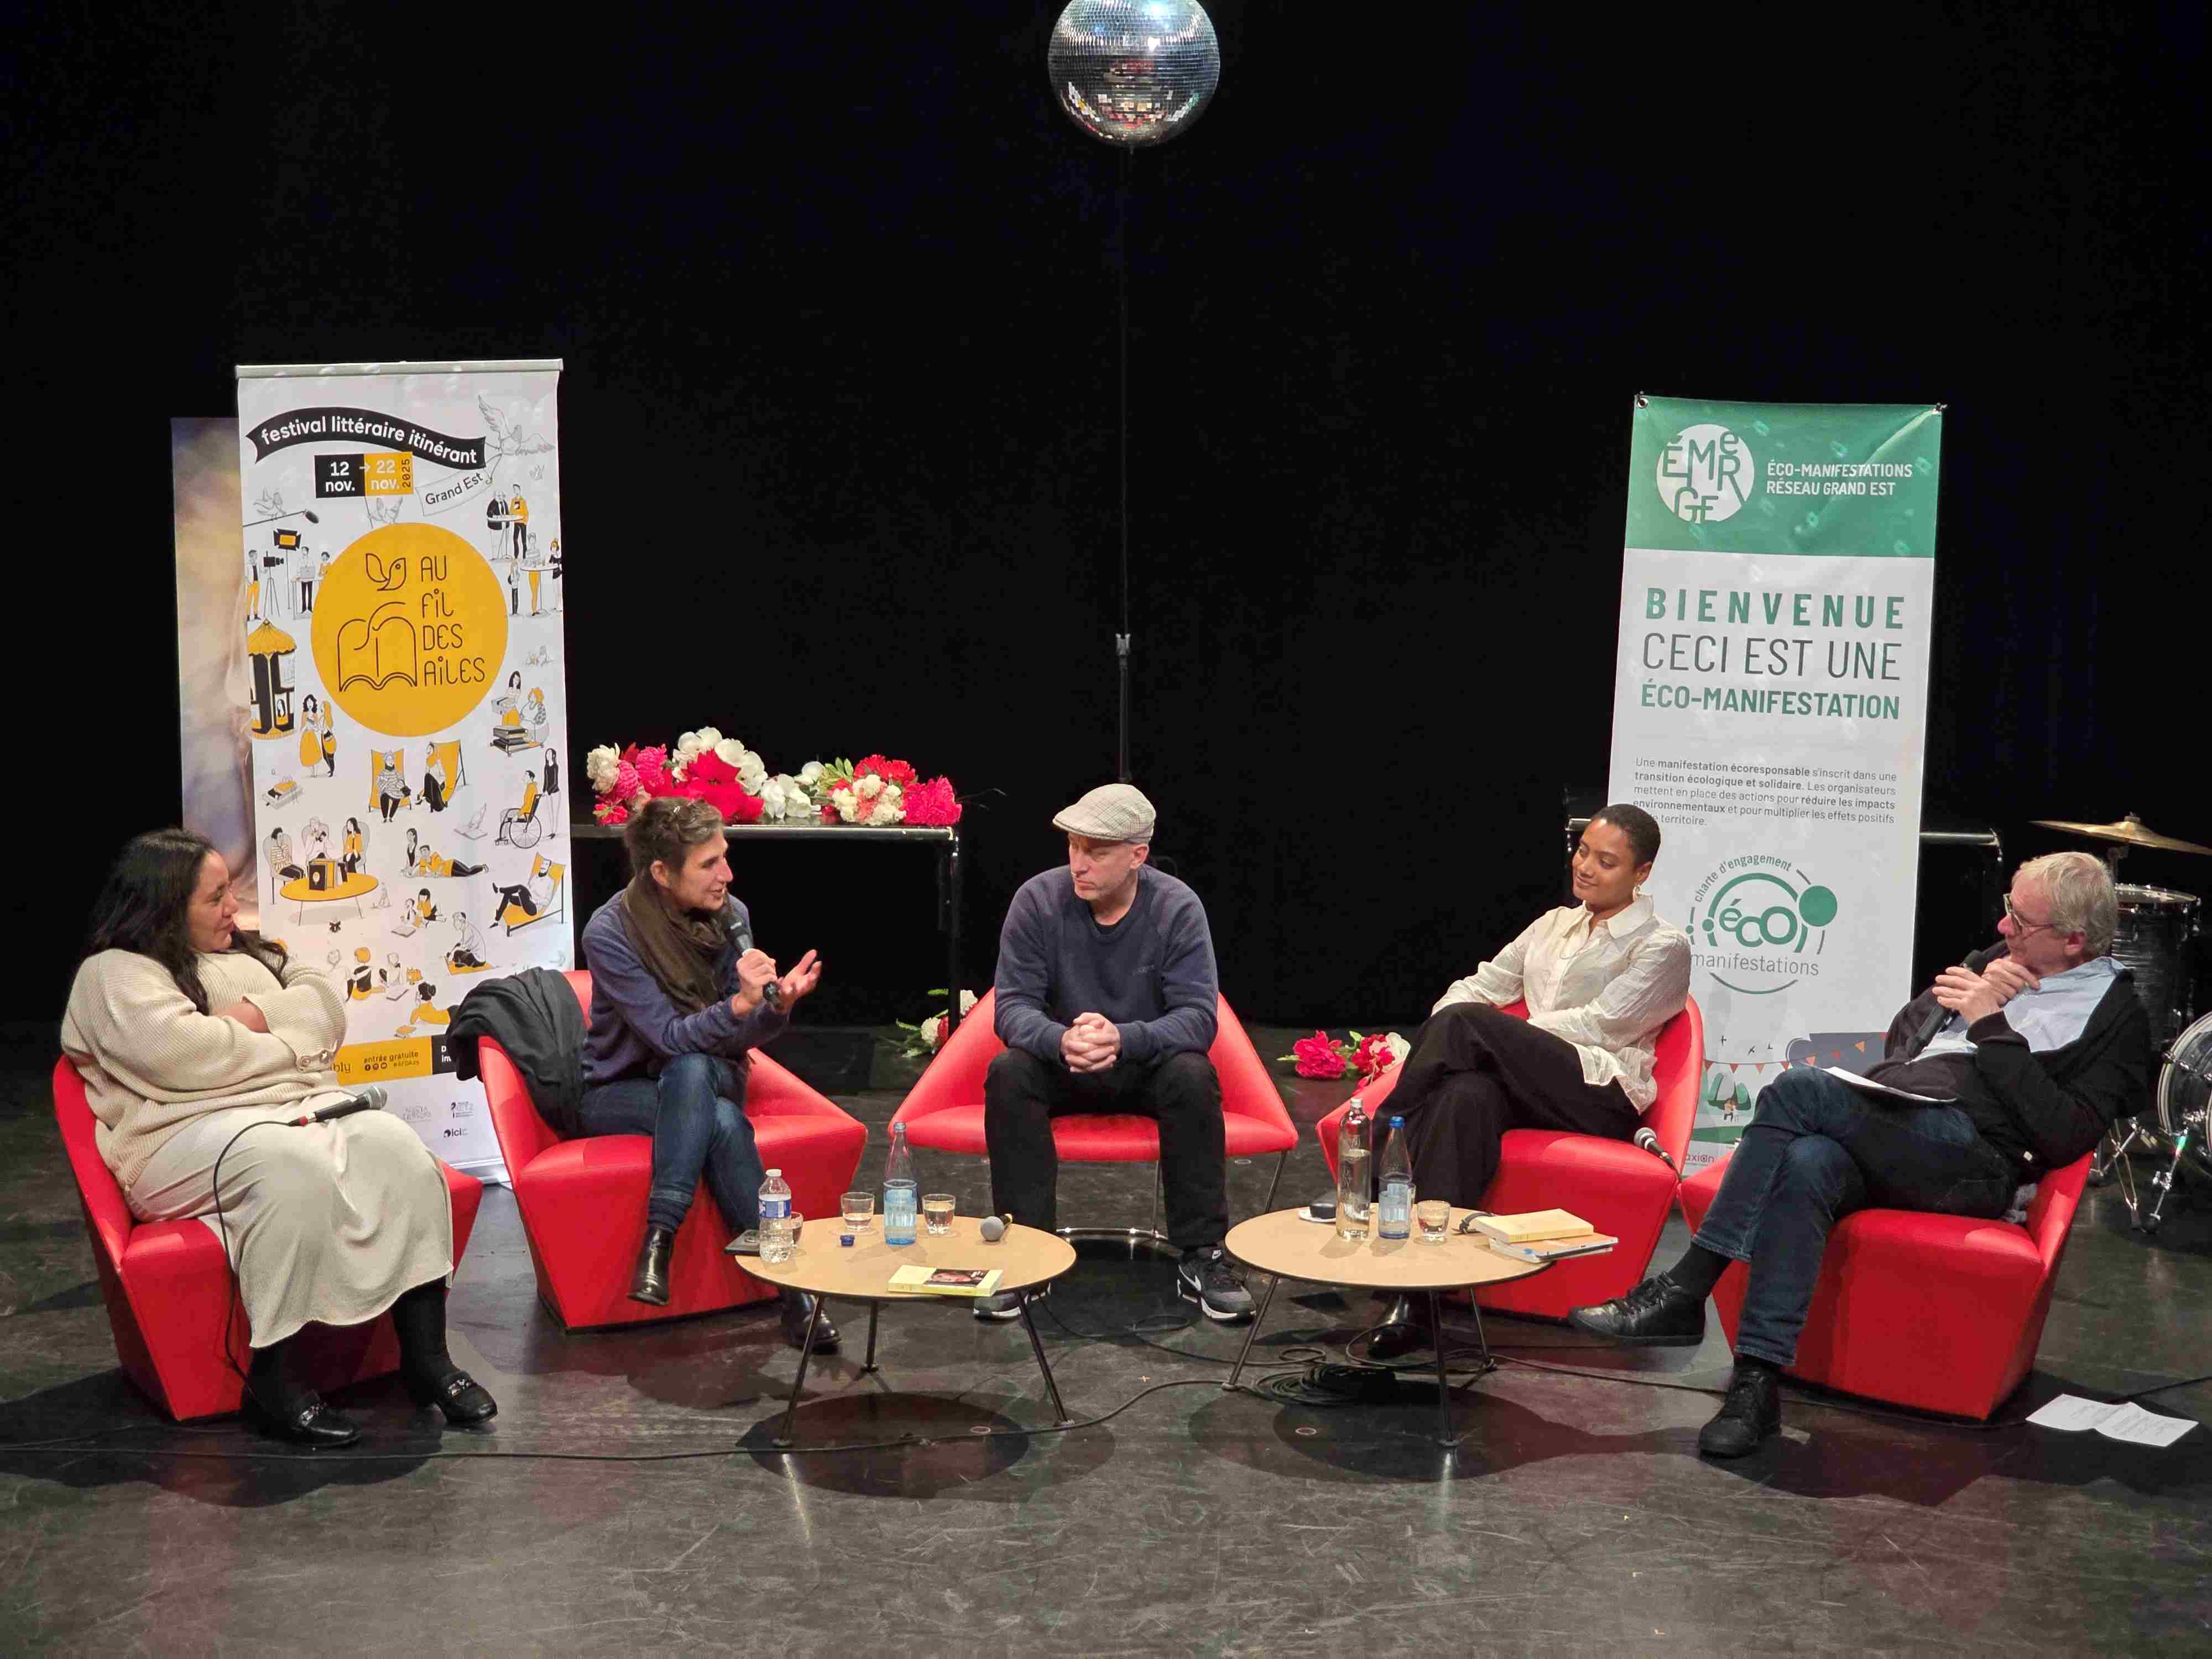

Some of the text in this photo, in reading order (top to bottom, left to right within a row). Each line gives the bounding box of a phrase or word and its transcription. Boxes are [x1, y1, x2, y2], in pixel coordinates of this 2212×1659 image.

[262, 416, 477, 463] festival littéraire itinérant
[330, 461, 349, 476] 12
[375, 460, 395, 474] 22
[401, 458, 411, 488] 2025
[1767, 458, 1913, 477] ÉCO-MANIFESTATIONS
[325, 480, 355, 492] nov.
[371, 478, 399, 490] nov.
[425, 472, 483, 504] Grand Est
[1766, 478, 1896, 495] RÉSEAU GRAND EST
[420, 555, 447, 582] AU
[1645, 587, 1905, 629] BIENVENUE
[422, 623, 463, 650] DES
[1642, 633, 1902, 681] CECI EST UNE
[1641, 679, 1900, 720] ÉCO-MANIFESTATION
[1635, 757, 1897, 781] Une manifestation écoresponsable s'inscrit dans une
[1635, 771, 1897, 795] transition écologique et solidaire. Les organisateurs
[1634, 786, 1896, 810] mettent en place des actions pour réduire les impacts
[1633, 800, 1894, 823] environnementaux et pour multiplier les effets positifs
[1661, 815, 1707, 826] territoire.
[1694, 854, 1792, 902] charte d'engagement
[1691, 953, 1819, 976] manifestations
[364, 1051, 419, 1063] entrée gratuite
